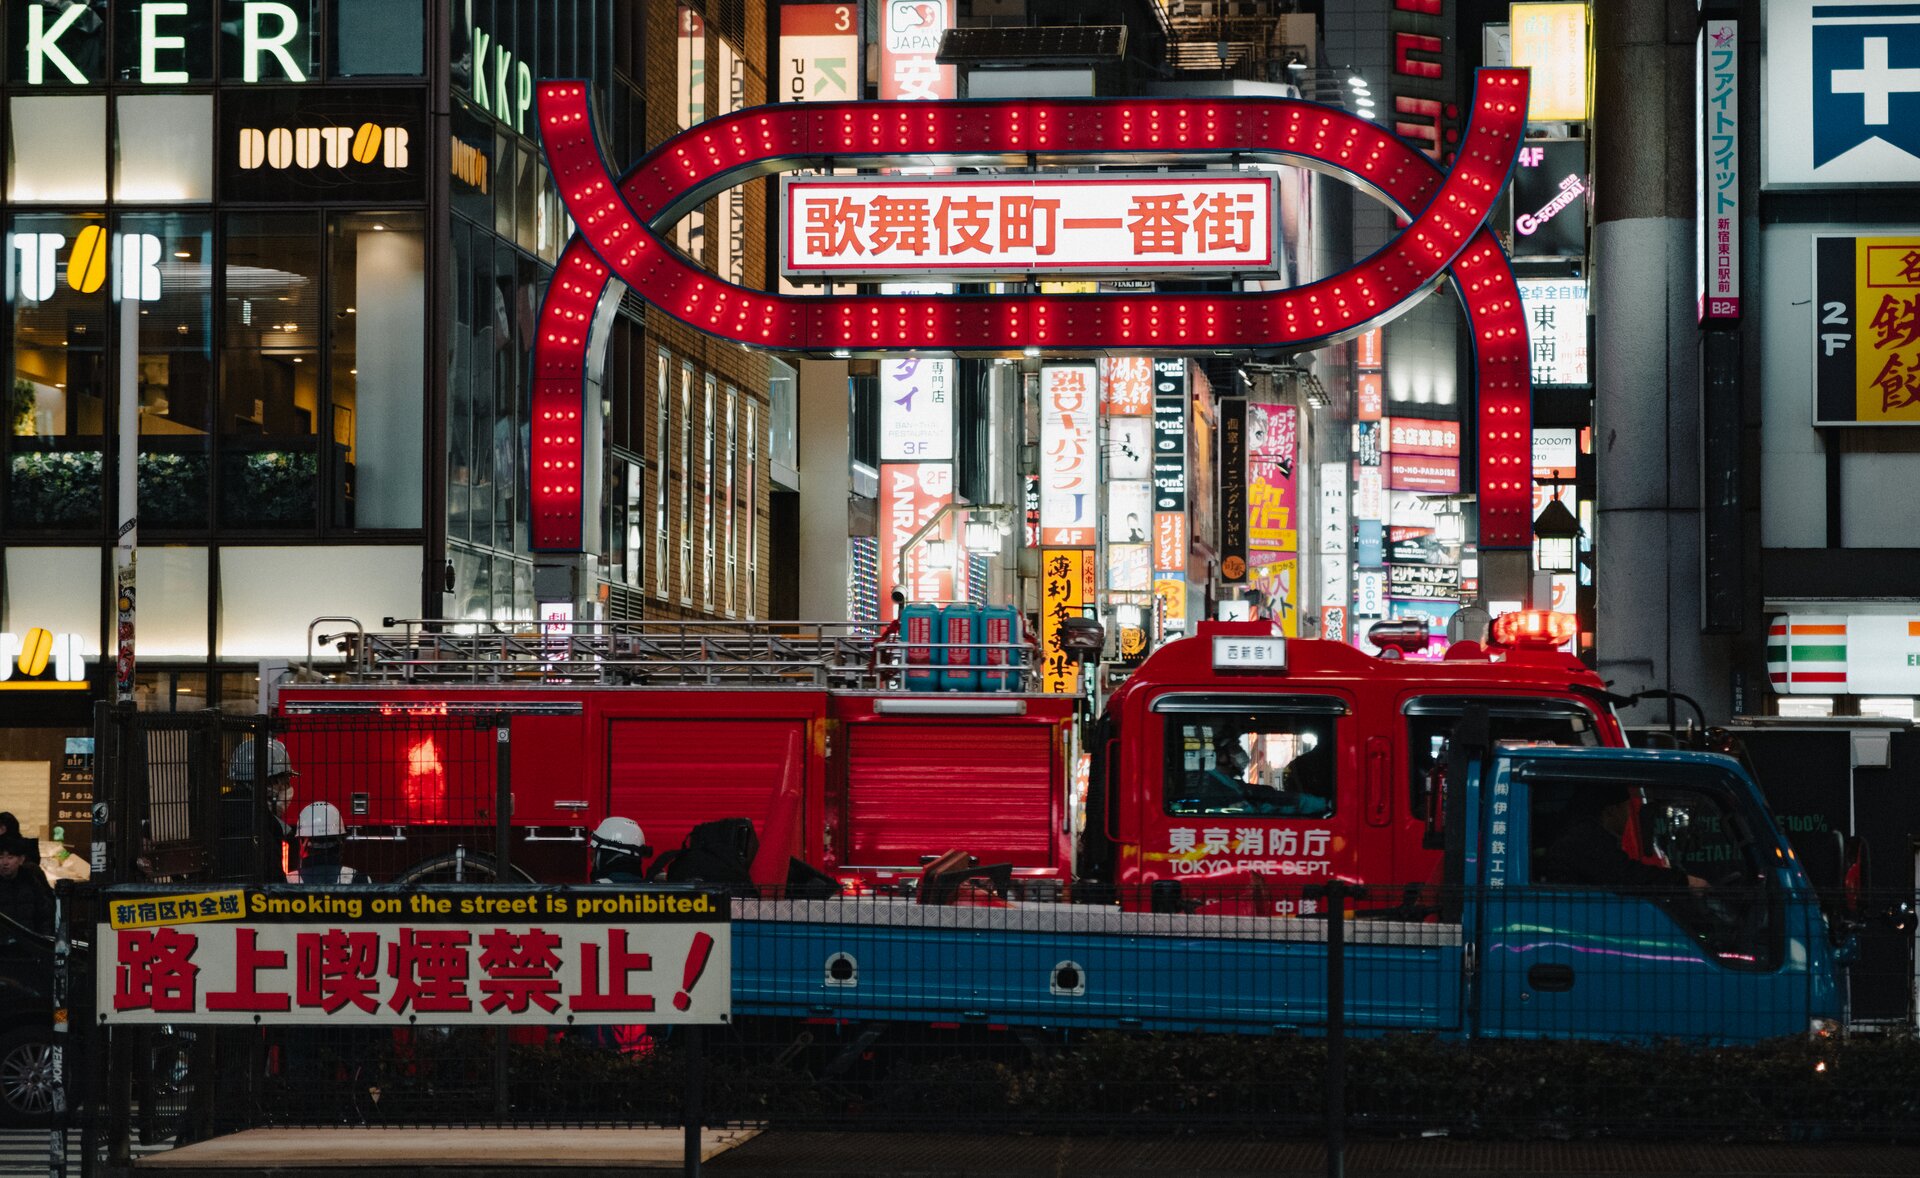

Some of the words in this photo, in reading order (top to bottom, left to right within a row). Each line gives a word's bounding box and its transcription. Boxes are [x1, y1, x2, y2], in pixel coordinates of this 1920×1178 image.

[834, 7, 850, 31] 3
[239, 122, 409, 169] DOUTOR
[1710, 50, 1735, 215] ファイトフィット
[1518, 147, 1544, 167] 4F
[805, 192, 1255, 257] 歌舞伎町一番街
[1717, 218, 1730, 292] 新宿東口駅前
[1712, 301, 1736, 315] B2F
[1821, 302, 1851, 357] 2F
[903, 442, 929, 455] 3F
[1393, 427, 1457, 448] 全店営業中
[926, 471, 948, 485] 2F
[1054, 531, 1083, 545] 4F
[1365, 576, 1376, 610] GiGO
[1168, 827, 1331, 856] 東京消防庁
[1168, 859, 1233, 874] TOKYO
[1236, 860, 1277, 875] FIRE
[1282, 861, 1334, 876] DEPT.
[117, 895, 240, 924] 新宿区内全域
[251, 894, 362, 918] Smoking
[371, 898, 402, 913] on
[410, 895, 451, 913] the
[461, 895, 538, 913] street
[546, 895, 568, 913] is
[577, 894, 716, 918] prohibited.
[113, 927, 715, 1015] 路上喫煙禁止!
